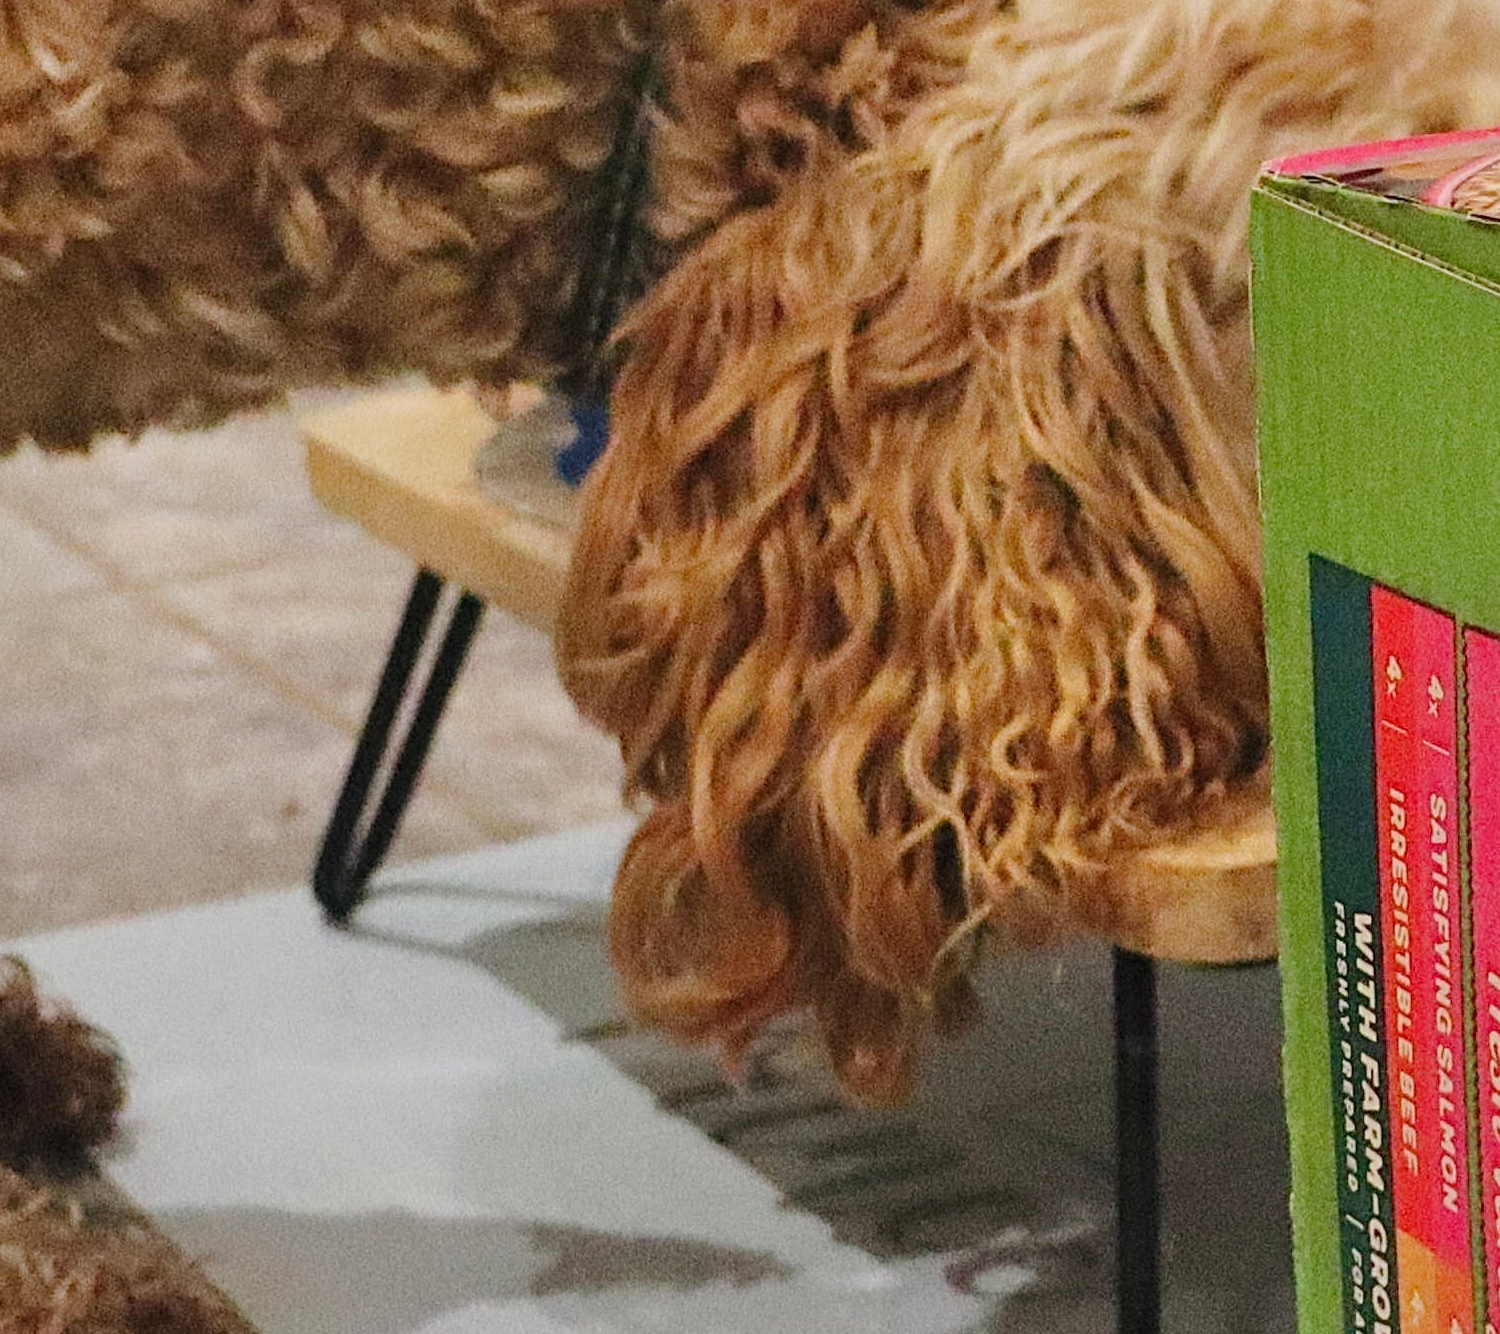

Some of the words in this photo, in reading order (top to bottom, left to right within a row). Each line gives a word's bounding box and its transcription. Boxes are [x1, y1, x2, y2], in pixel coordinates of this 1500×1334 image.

[1334, 900, 1351, 1033] FRESHLY
[1353, 912, 1378, 1043] WITH
[1388, 787, 1414, 1064] IRRESISTIBLE
[1427, 795, 1453, 1038] SATISFYING
[1340, 1039, 1360, 1194] PREPARED
[1399, 1071, 1419, 1176] BEEF
[1435, 1044, 1459, 1214] SALMON
